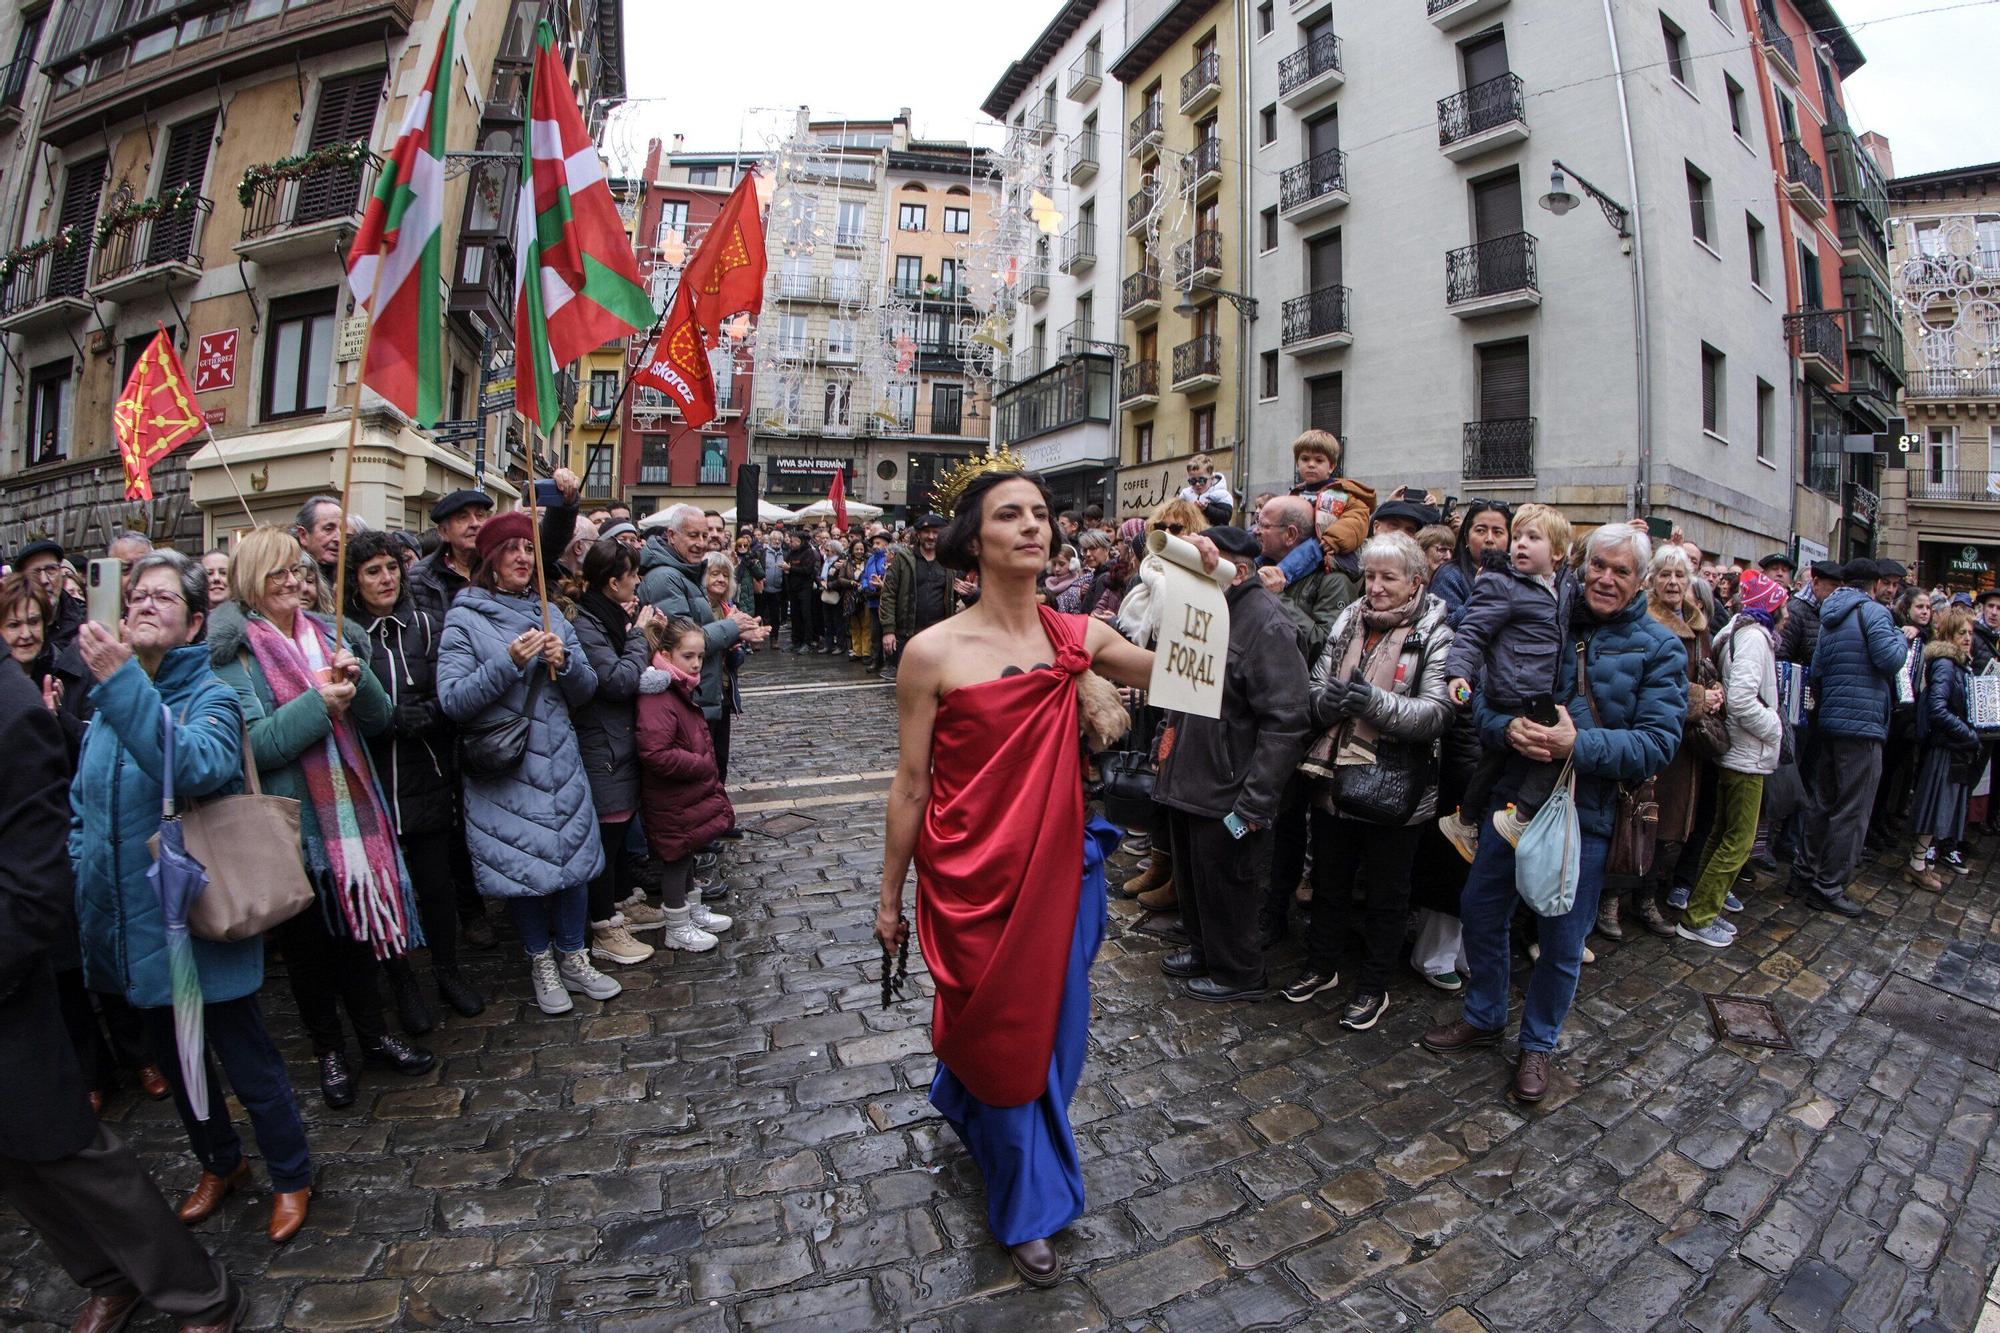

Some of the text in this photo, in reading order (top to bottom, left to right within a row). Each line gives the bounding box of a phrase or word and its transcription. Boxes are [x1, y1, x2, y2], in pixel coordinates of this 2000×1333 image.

[199, 354, 233, 367] GUTIERREZ
[650, 360, 695, 404] skaraz
[1898, 435, 1919, 452] 8°
[797, 459, 815, 468] SAN
[1123, 478, 1149, 491] COFFEE
[1951, 559, 1988, 571] TABERNA
[1182, 602, 1214, 645] LEY
[1165, 640, 1215, 693] FORAL
